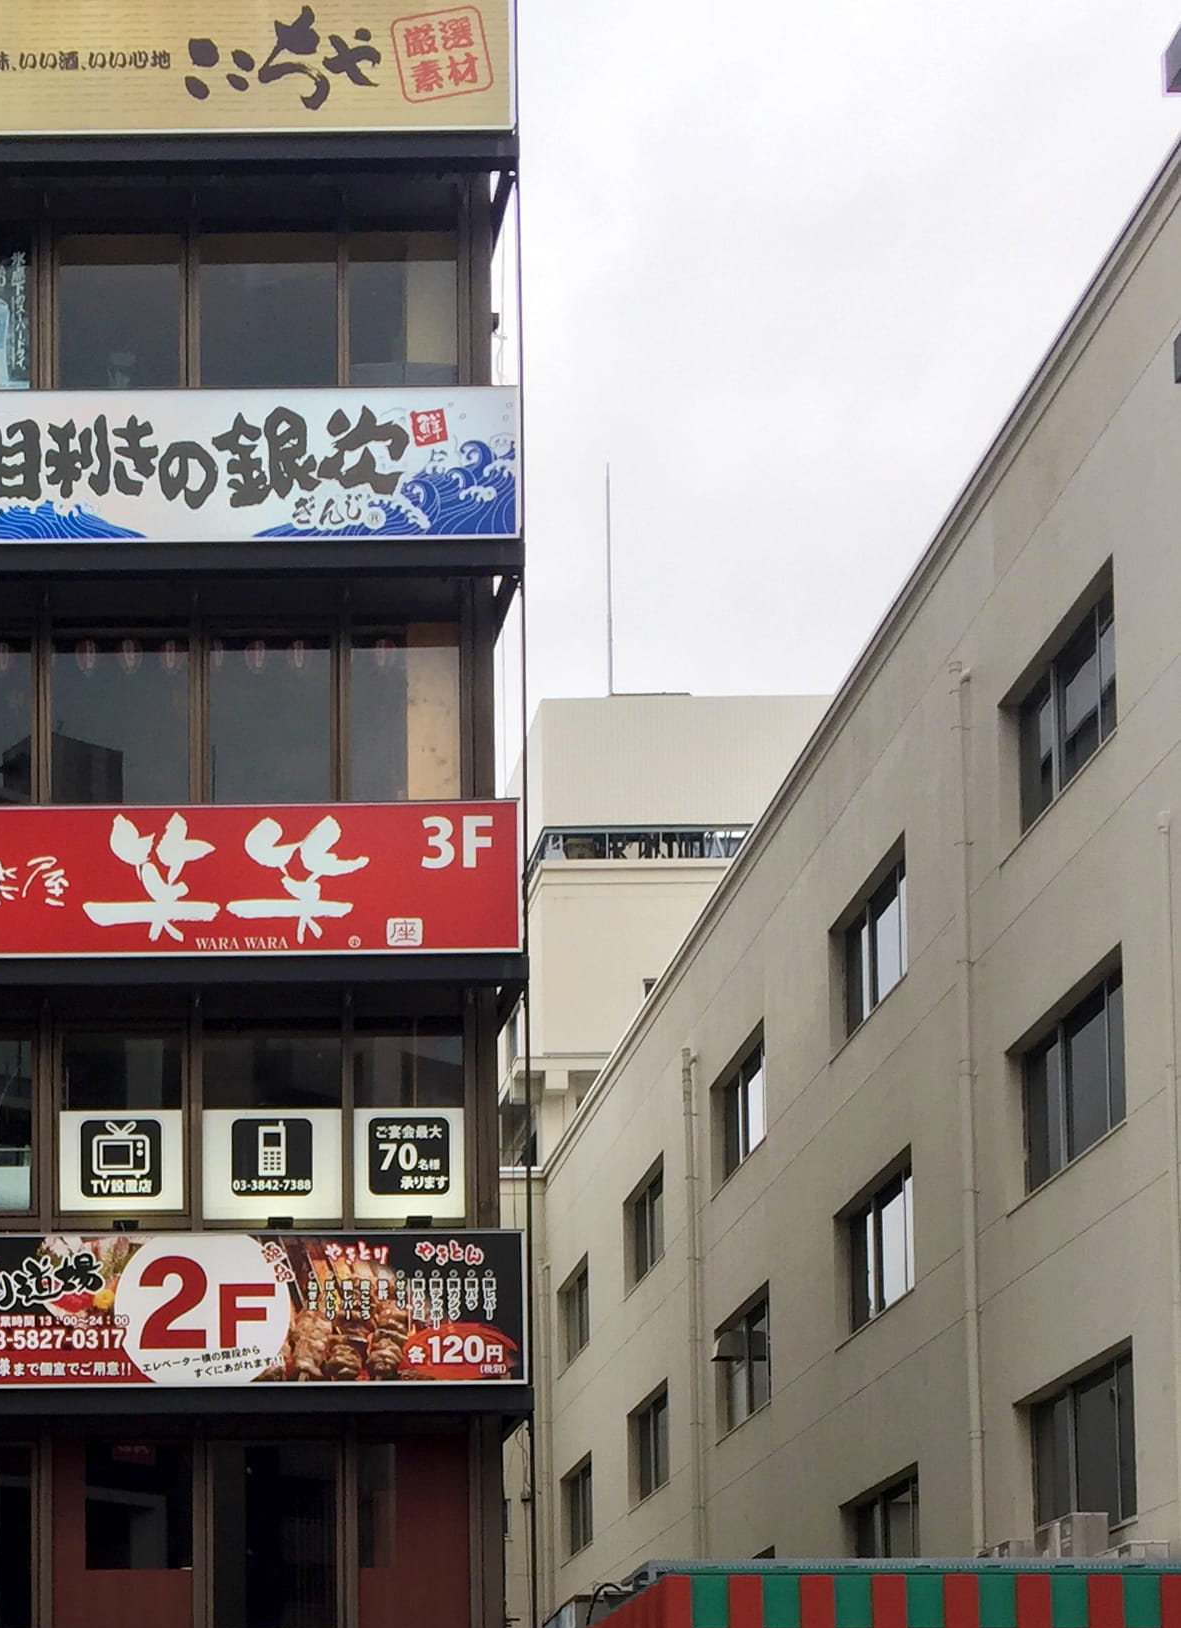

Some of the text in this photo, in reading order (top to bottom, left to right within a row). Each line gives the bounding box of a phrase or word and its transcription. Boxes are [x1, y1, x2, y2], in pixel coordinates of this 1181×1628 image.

[402, 17, 473, 57] 厳選
[409, 52, 479, 93] 素材
[291, 494, 363, 528] ぎんじ
[420, 815, 494, 869] 3F
[82, 811, 370, 944] 笑笑
[195, 935, 289, 951] WARA WARA
[375, 1124, 443, 1140] ご宴会最大
[91, 1177, 152, 1195] TV設置店
[233, 1179, 313, 1193] 03-3842-7388
[400, 1174, 449, 1191] 承ります
[324, 1242, 390, 1266] やきとり
[415, 1240, 485, 1266] やきとん
[139, 1255, 276, 1350] 2F
[408, 1335, 504, 1364] 各120円
